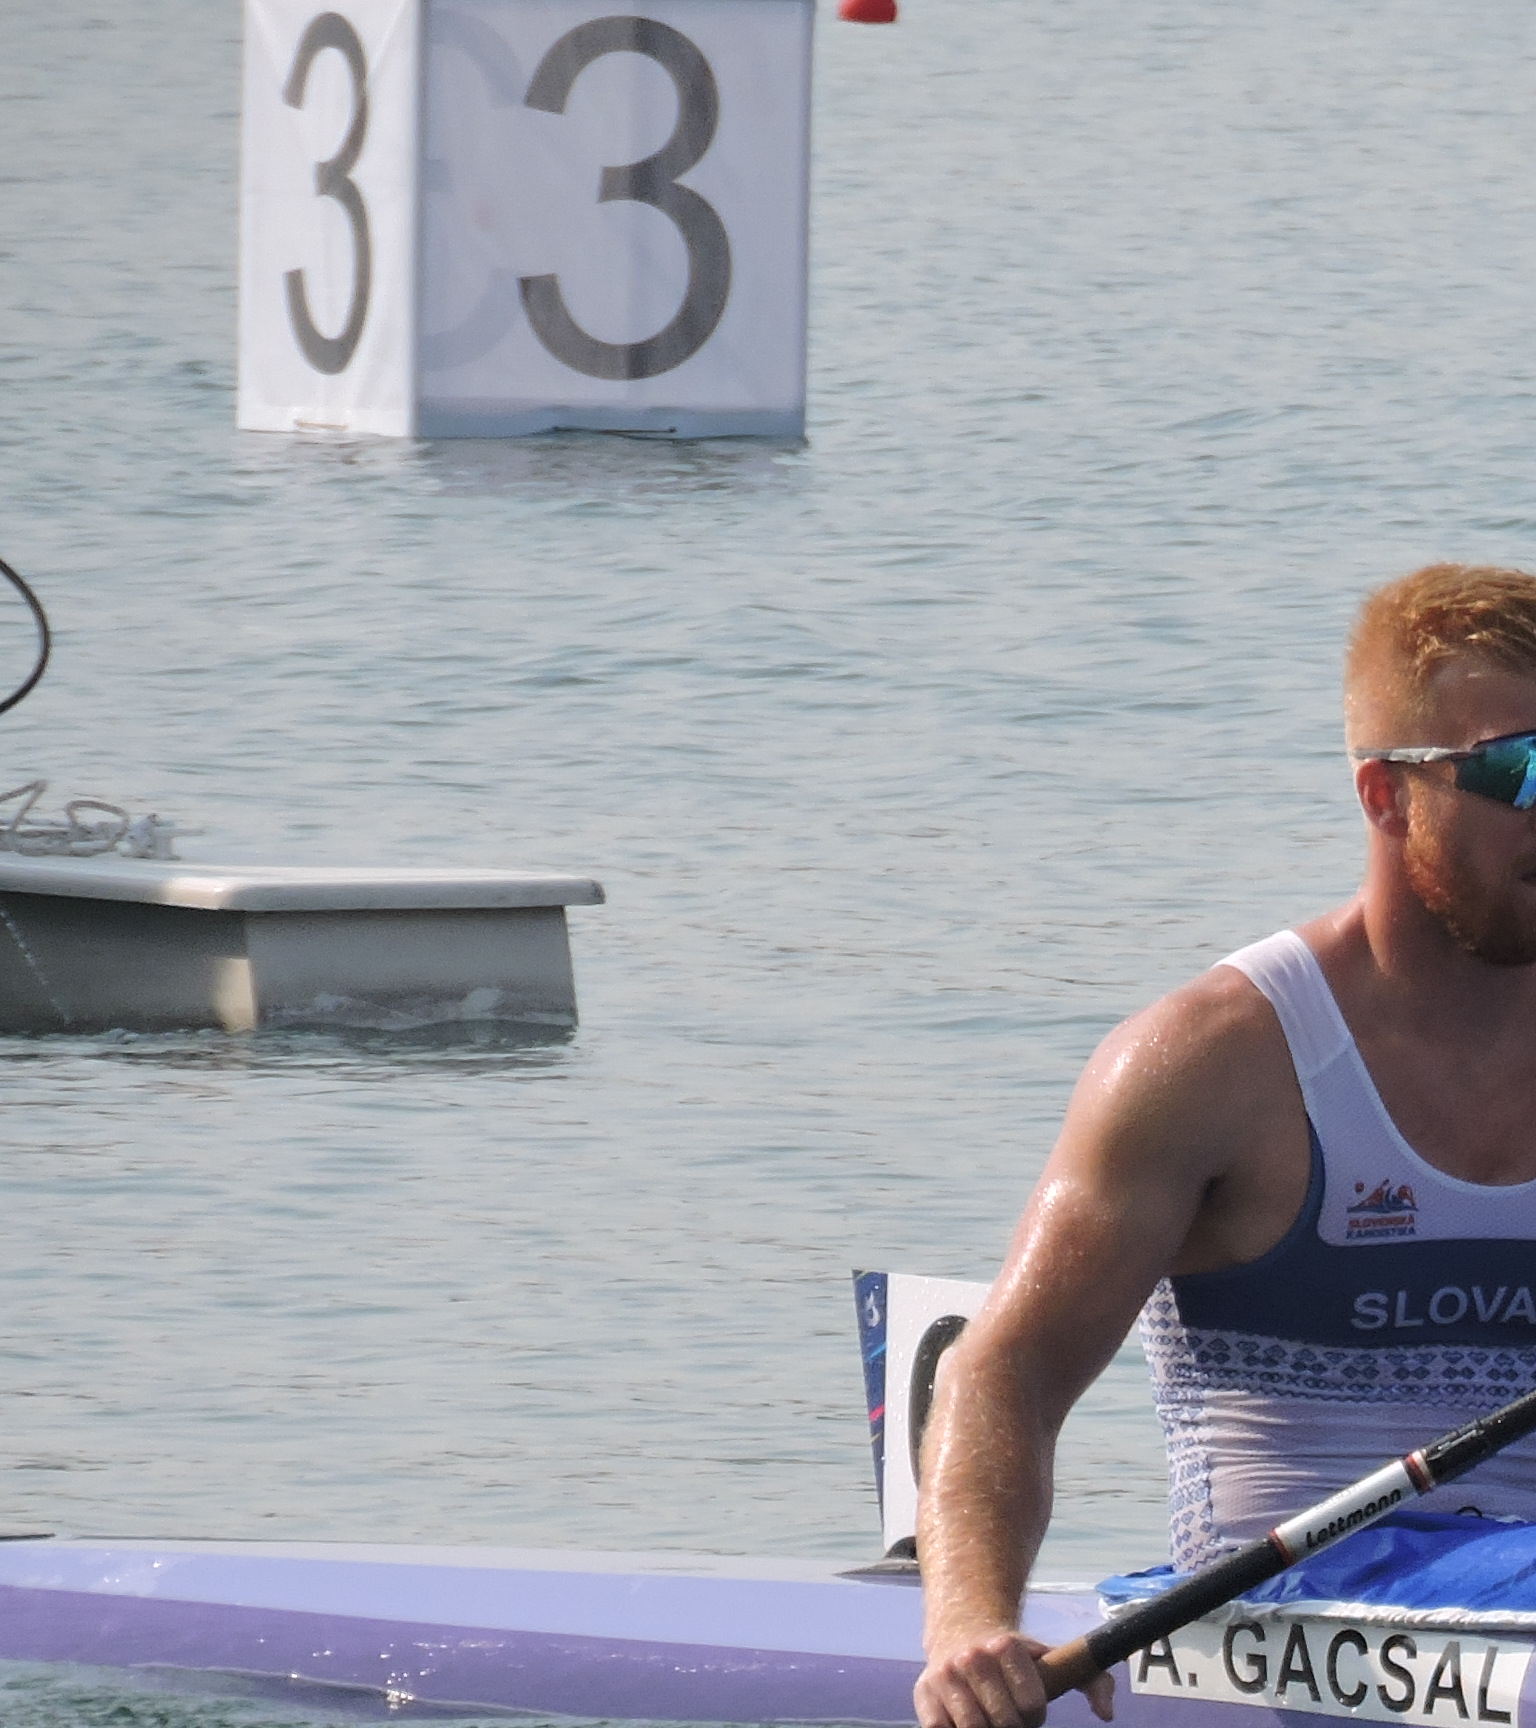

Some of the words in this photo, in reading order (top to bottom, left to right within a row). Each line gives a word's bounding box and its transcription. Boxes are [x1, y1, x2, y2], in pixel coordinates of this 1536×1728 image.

[283, 11, 371, 375] 3
[518, 15, 733, 380] 3
[1305, 1488, 1402, 1549] Lettmann
[1137, 1633, 1199, 1688] A.
[1222, 1620, 1512, 1725] GACSAL
